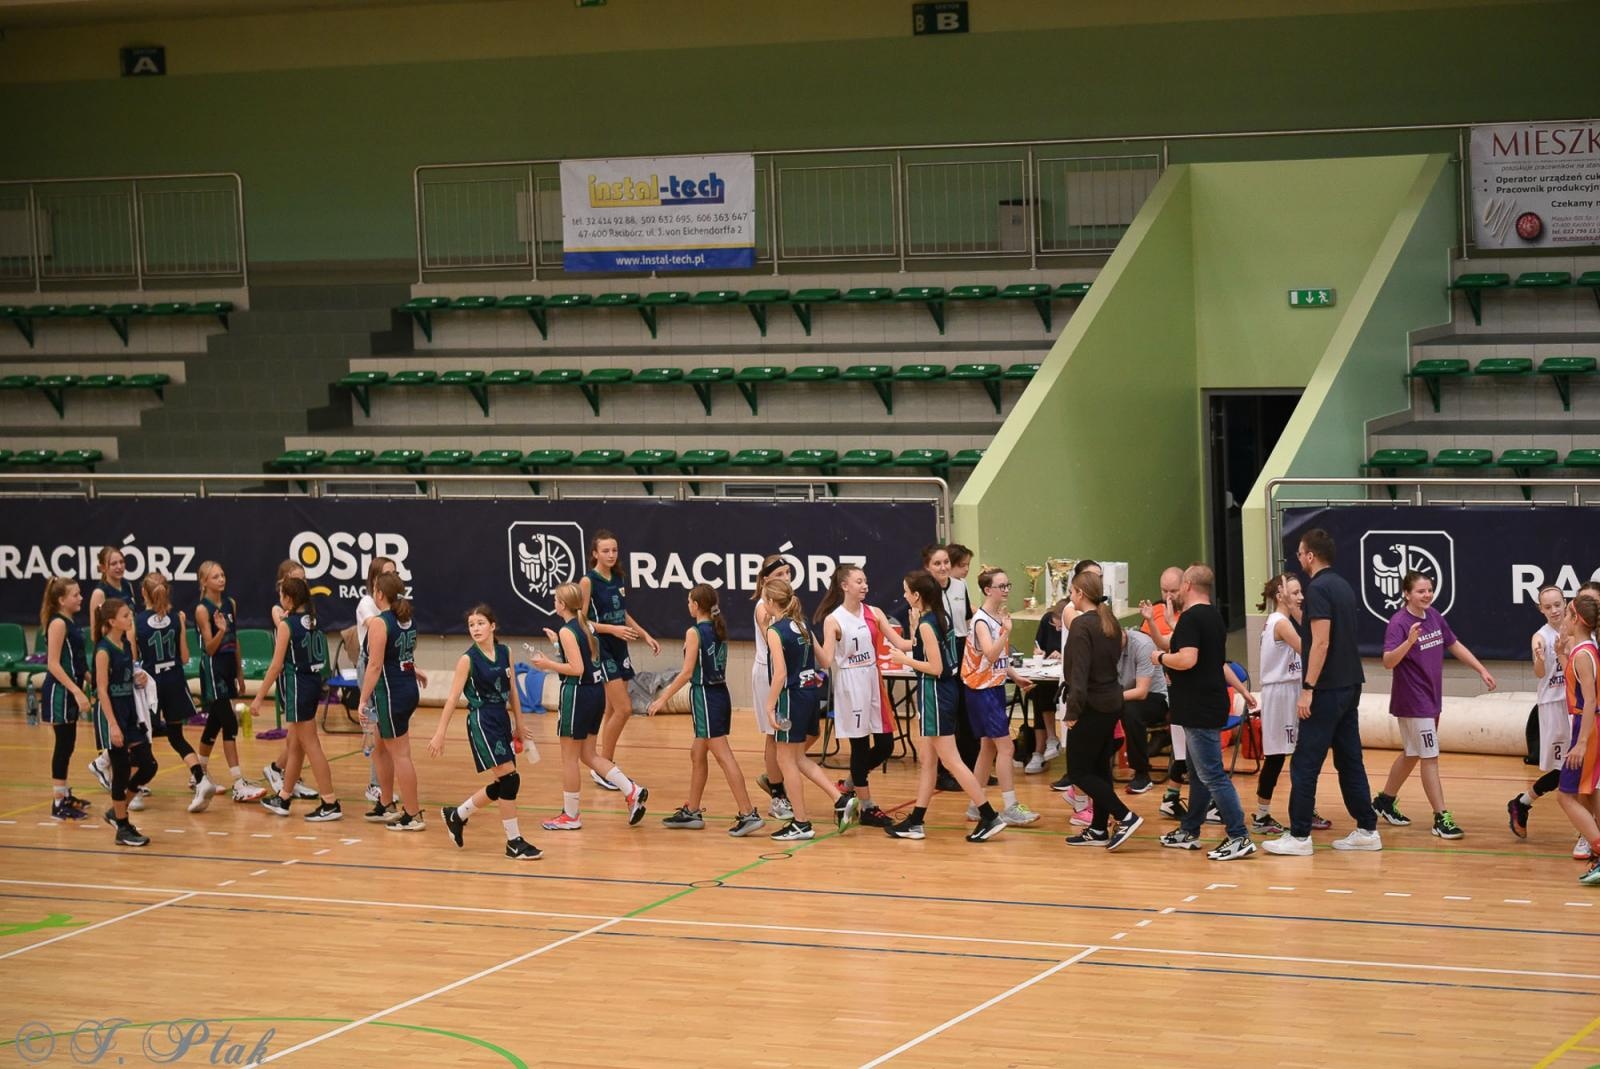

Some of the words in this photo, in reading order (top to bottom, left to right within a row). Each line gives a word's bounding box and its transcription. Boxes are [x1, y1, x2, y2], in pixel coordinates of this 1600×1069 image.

[936, 12, 960, 31] B
[133, 56, 159, 73] A
[1495, 175, 1537, 184] Operator
[1539, 172, 1582, 183] urządzeń
[587, 172, 725, 208] instal-tech
[1496, 184, 1544, 194] Pracownik
[1551, 199, 1593, 208] Czekamy
[586, 217, 596, 225] 32
[613, 216, 623, 225] 92
[696, 213, 712, 223] 606
[731, 211, 747, 222] 647
[578, 229, 607, 238] 47-400
[666, 229, 681, 237] von
[682, 225, 735, 236] Eichendorffa
[736, 225, 742, 234] 2
[616, 252, 705, 267] www.instal-tech.pl
[288, 531, 412, 582] OSiR
[629, 540, 867, 592] RACIBÓR
[1511, 564, 1600, 604] RA
[147, 629, 177, 662] 11
[848, 651, 871, 664] MINI
[1421, 732, 1434, 748] 18
[1554, 745, 1562, 761] 2
